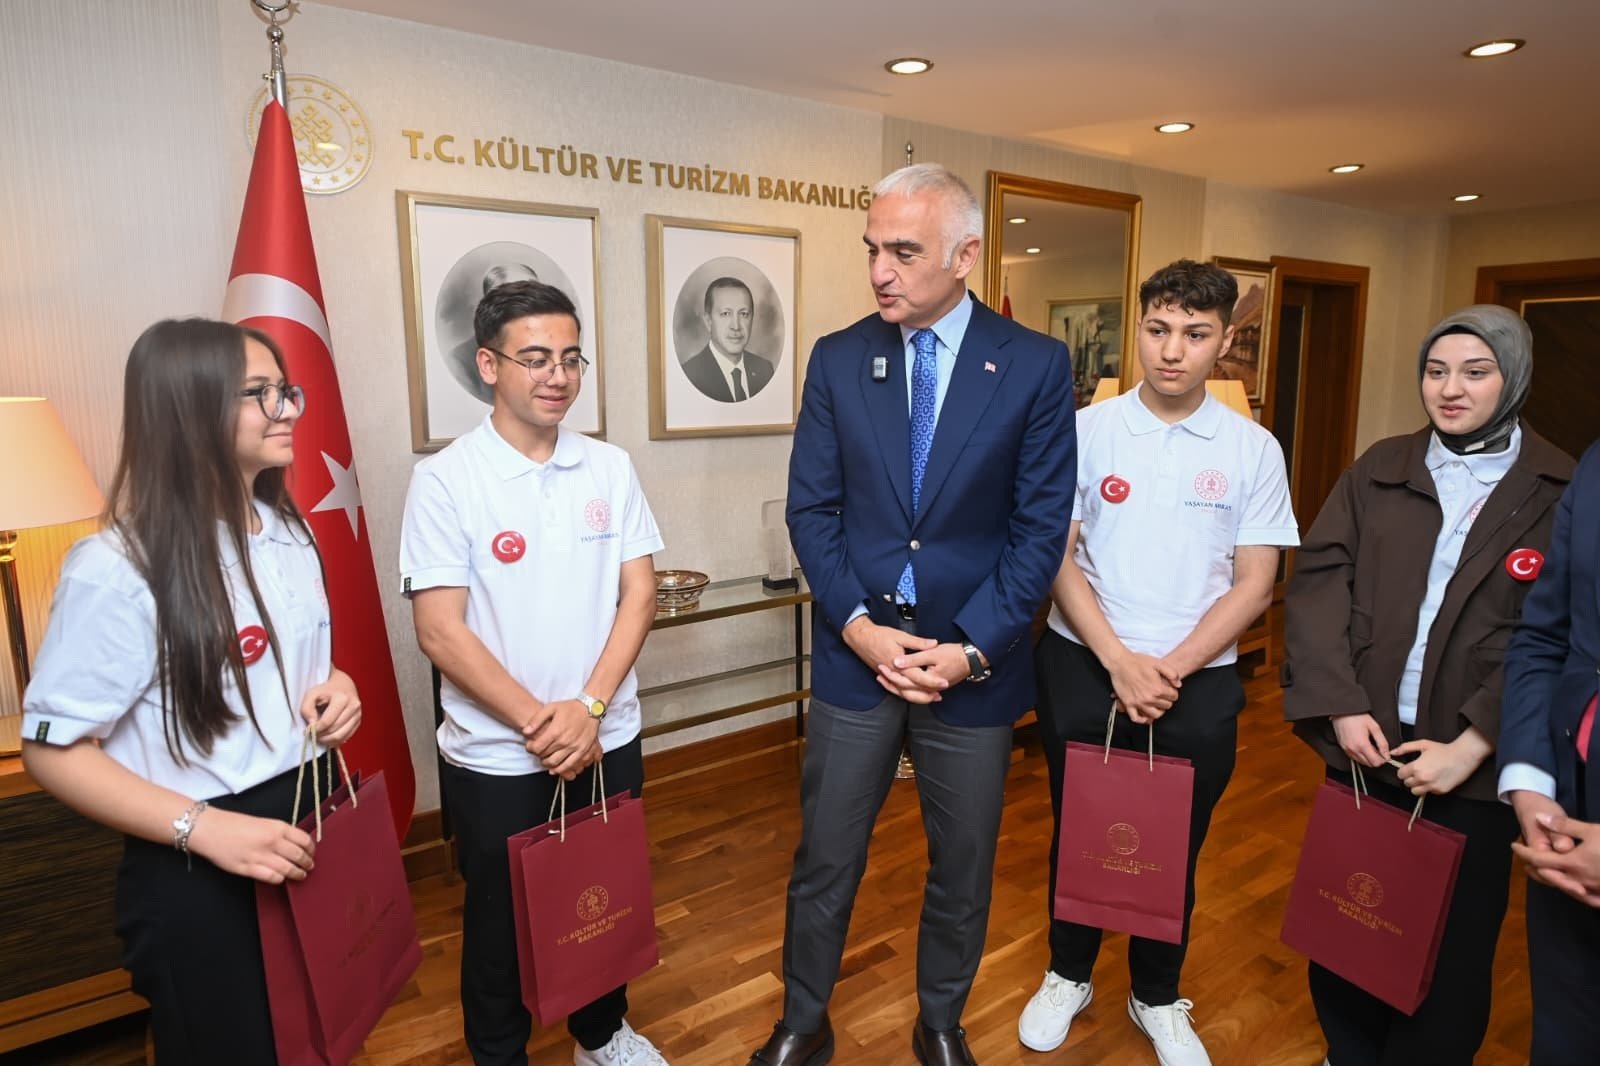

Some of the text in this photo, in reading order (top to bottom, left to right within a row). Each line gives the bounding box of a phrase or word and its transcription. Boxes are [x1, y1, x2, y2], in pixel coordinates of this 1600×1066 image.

[402, 129, 465, 164] T.C.
[474, 136, 599, 179] KÜLTÜR
[606, 156, 642, 184] VE
[649, 162, 750, 197] TURİZM
[570, 922, 597, 939] KÜLTÜR
